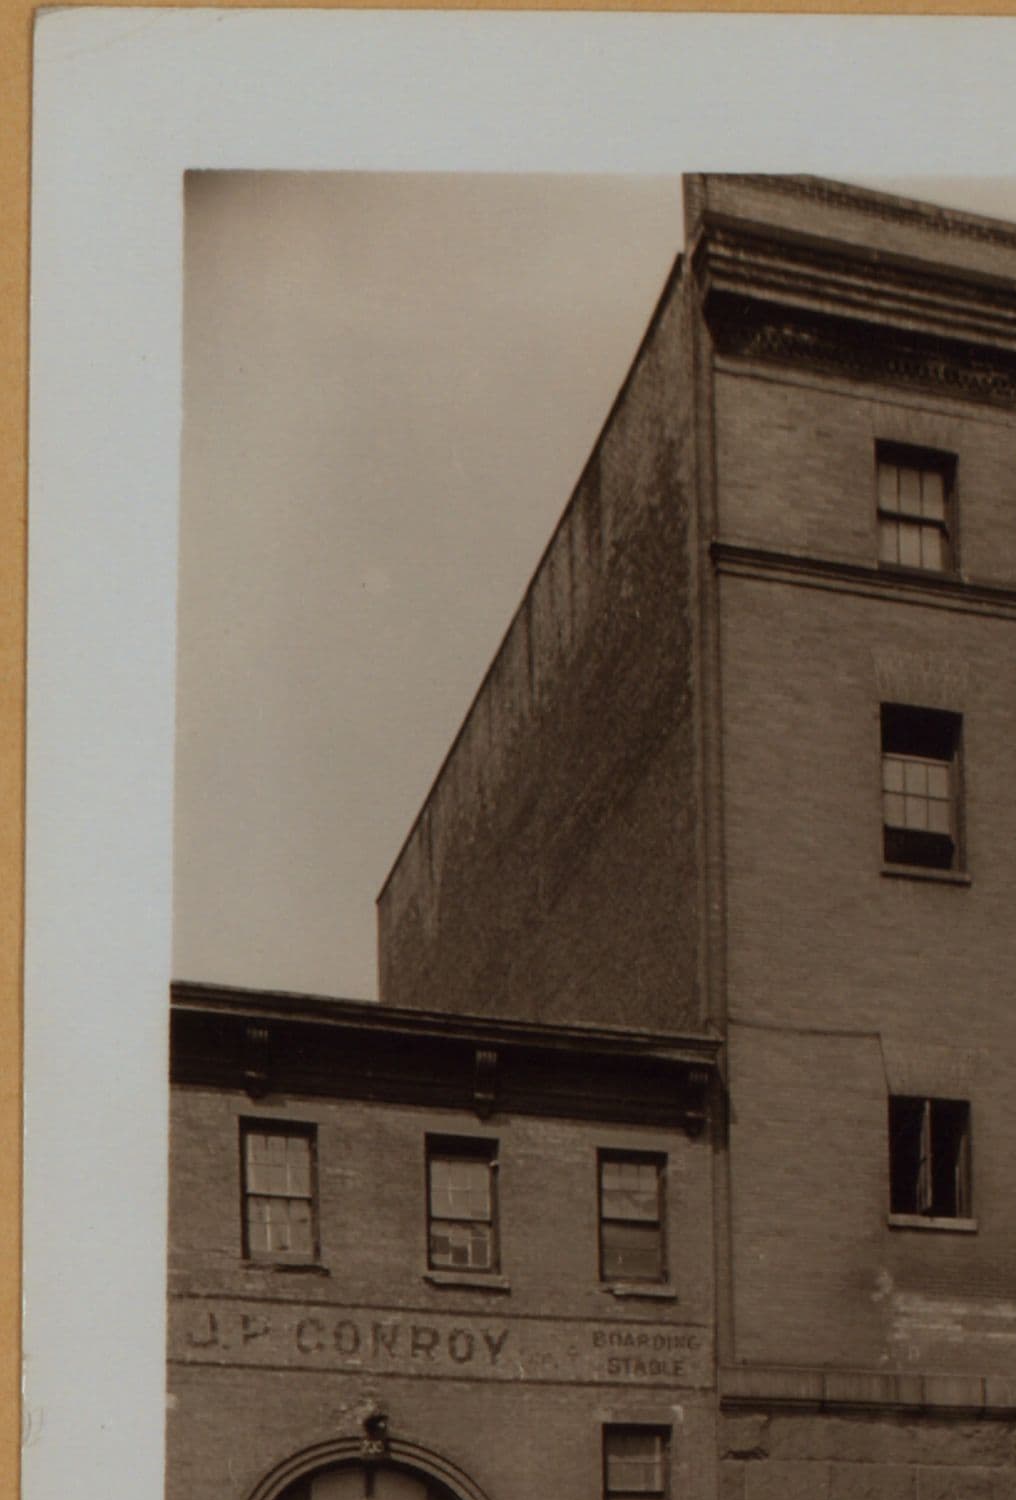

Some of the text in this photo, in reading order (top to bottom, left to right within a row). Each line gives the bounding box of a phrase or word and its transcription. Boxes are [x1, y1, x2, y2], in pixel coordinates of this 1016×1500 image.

[296, 1317, 509, 1365] CONROY
[592, 1329, 702, 1351] BOARDING
[606, 1357, 685, 1378] STABLE
